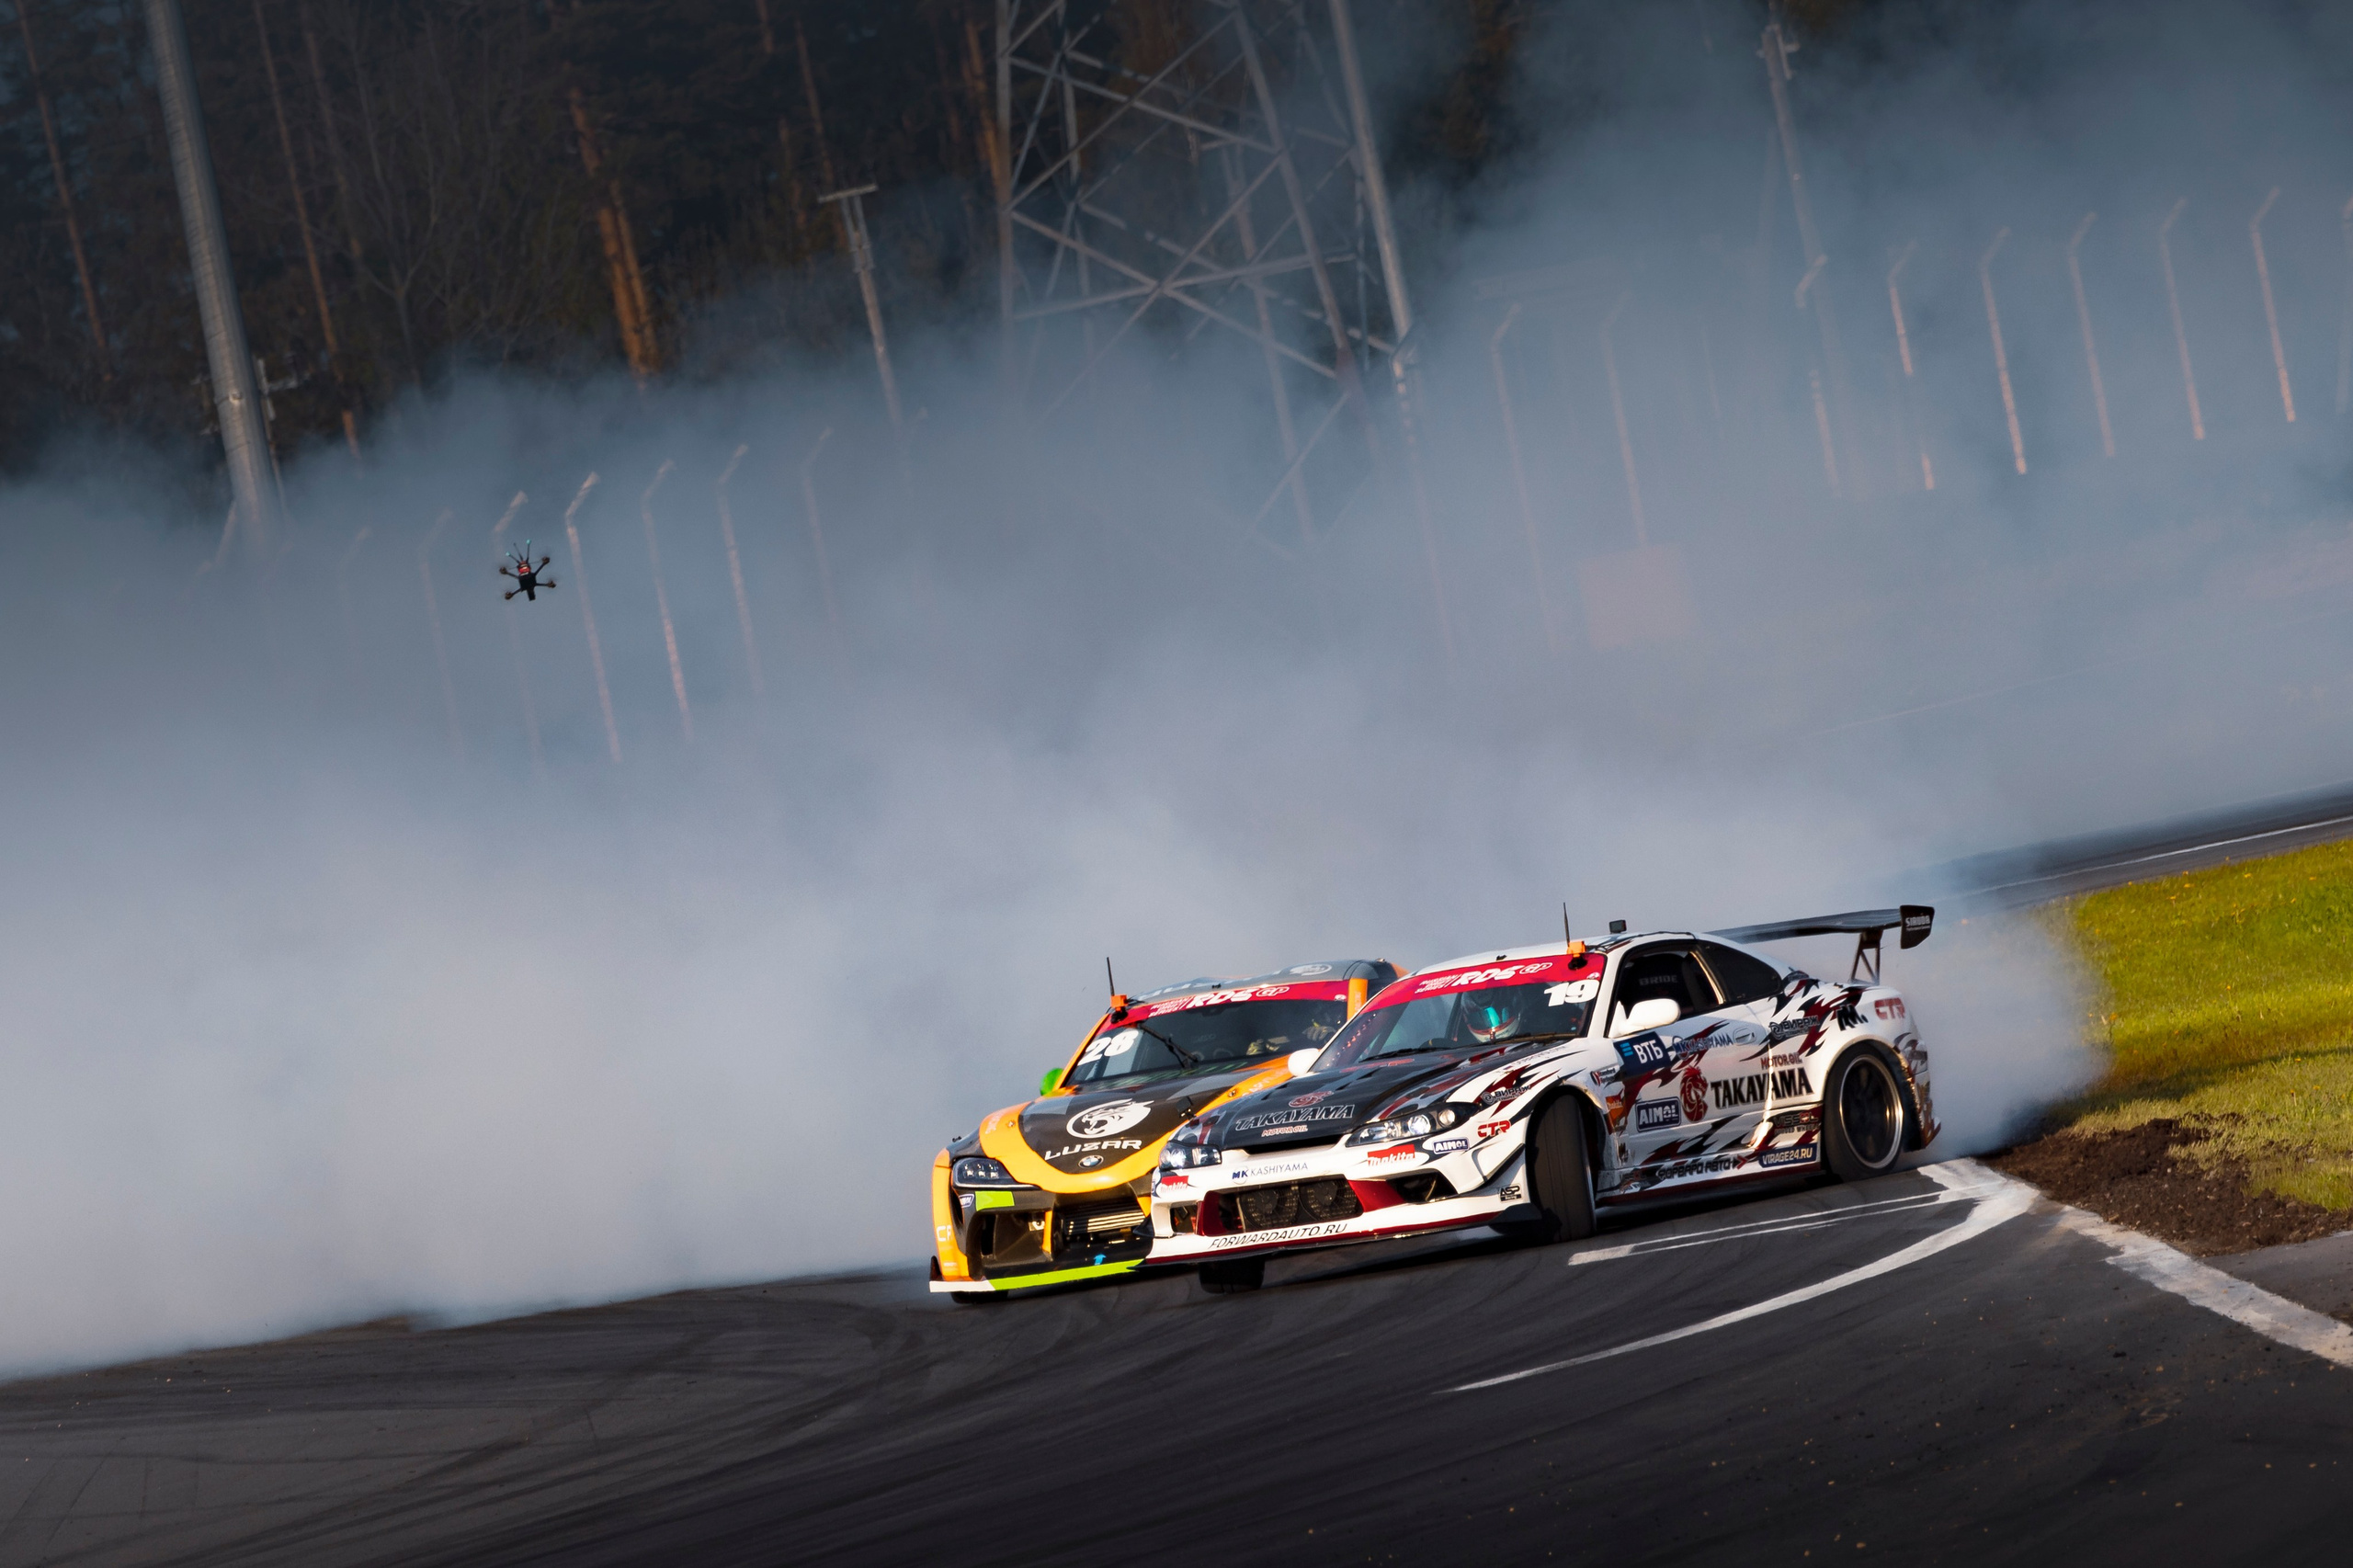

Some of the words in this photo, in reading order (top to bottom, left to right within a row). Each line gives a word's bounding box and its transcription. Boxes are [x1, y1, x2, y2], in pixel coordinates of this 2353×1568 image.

[1451, 965, 1526, 987] RDS
[1639, 974, 1678, 986] BRIDE
[1186, 988, 1260, 1009] RDS
[1543, 979, 1599, 1007] 19
[1874, 997, 1905, 1020] CTR
[1077, 1028, 1139, 1066] 28
[1632, 1040, 1664, 1064] ВТБ
[1711, 1067, 1814, 1109] TAKAYAMA
[1235, 1104, 1355, 1131] TAKAYAMA
[1639, 1105, 1679, 1126] AIMOL
[1477, 1119, 1511, 1138] CTR
[1044, 1140, 1142, 1161] LUZAR
[1435, 1139, 1468, 1153] AIMOL
[1762, 1147, 1813, 1165] VIRAGE24.RU
[1233, 1170, 1249, 1180] MK
[1250, 1162, 1309, 1176] KASHIYAMA
[1209, 1222, 1348, 1250] FORWARDAUTO.RU
